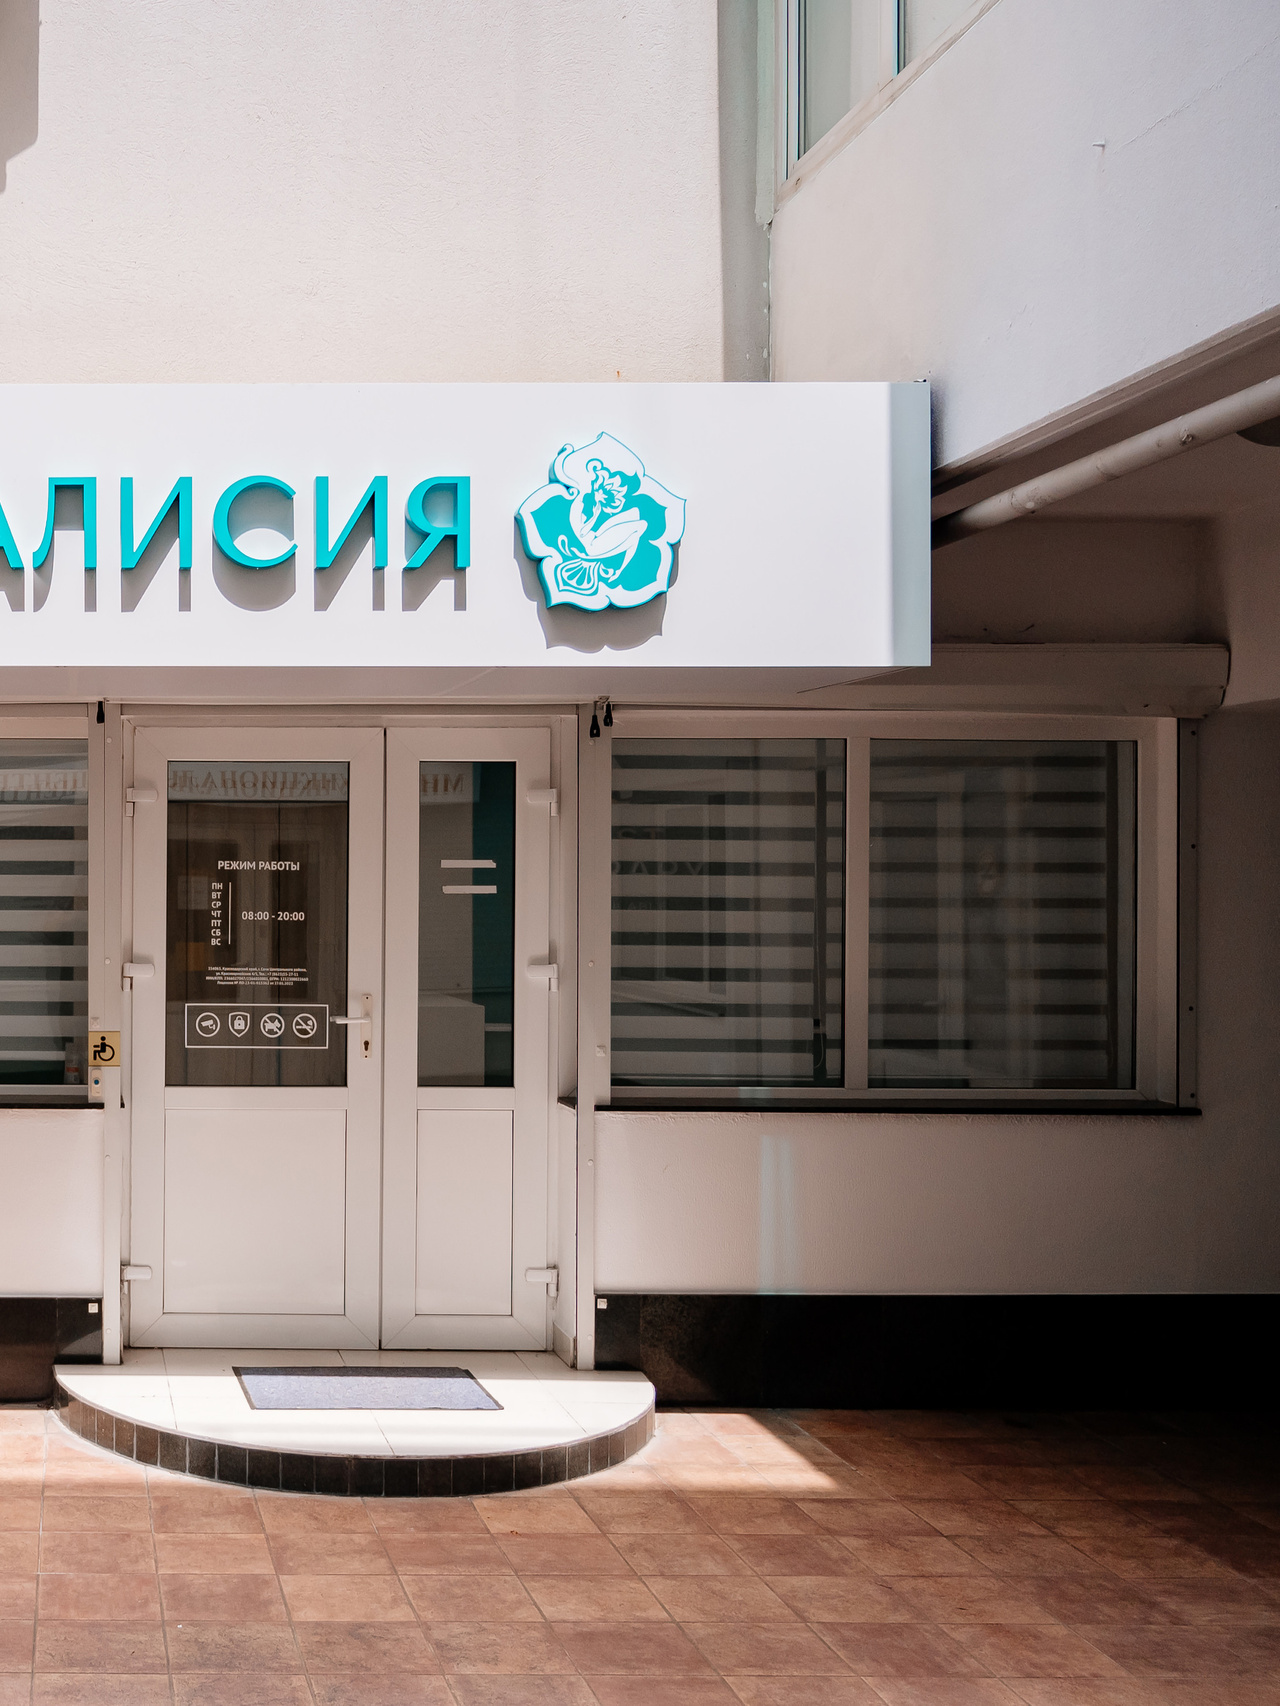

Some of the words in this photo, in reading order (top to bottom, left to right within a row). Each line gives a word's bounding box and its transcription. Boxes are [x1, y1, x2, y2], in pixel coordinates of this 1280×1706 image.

[217, 860, 256, 871] РЕЖИМ
[258, 861, 300, 871] РАБОТЫ
[211, 882, 223, 890] ПН
[211, 892, 222, 900] ВТ
[211, 901, 222, 909] СР
[211, 910, 222, 918] ЧТ
[241, 910, 270, 921] 08:00
[277, 911, 305, 921] 20:00
[211, 919, 222, 927] ПТ
[211, 929, 222, 937] СБ
[211, 938, 222, 946] ВС
